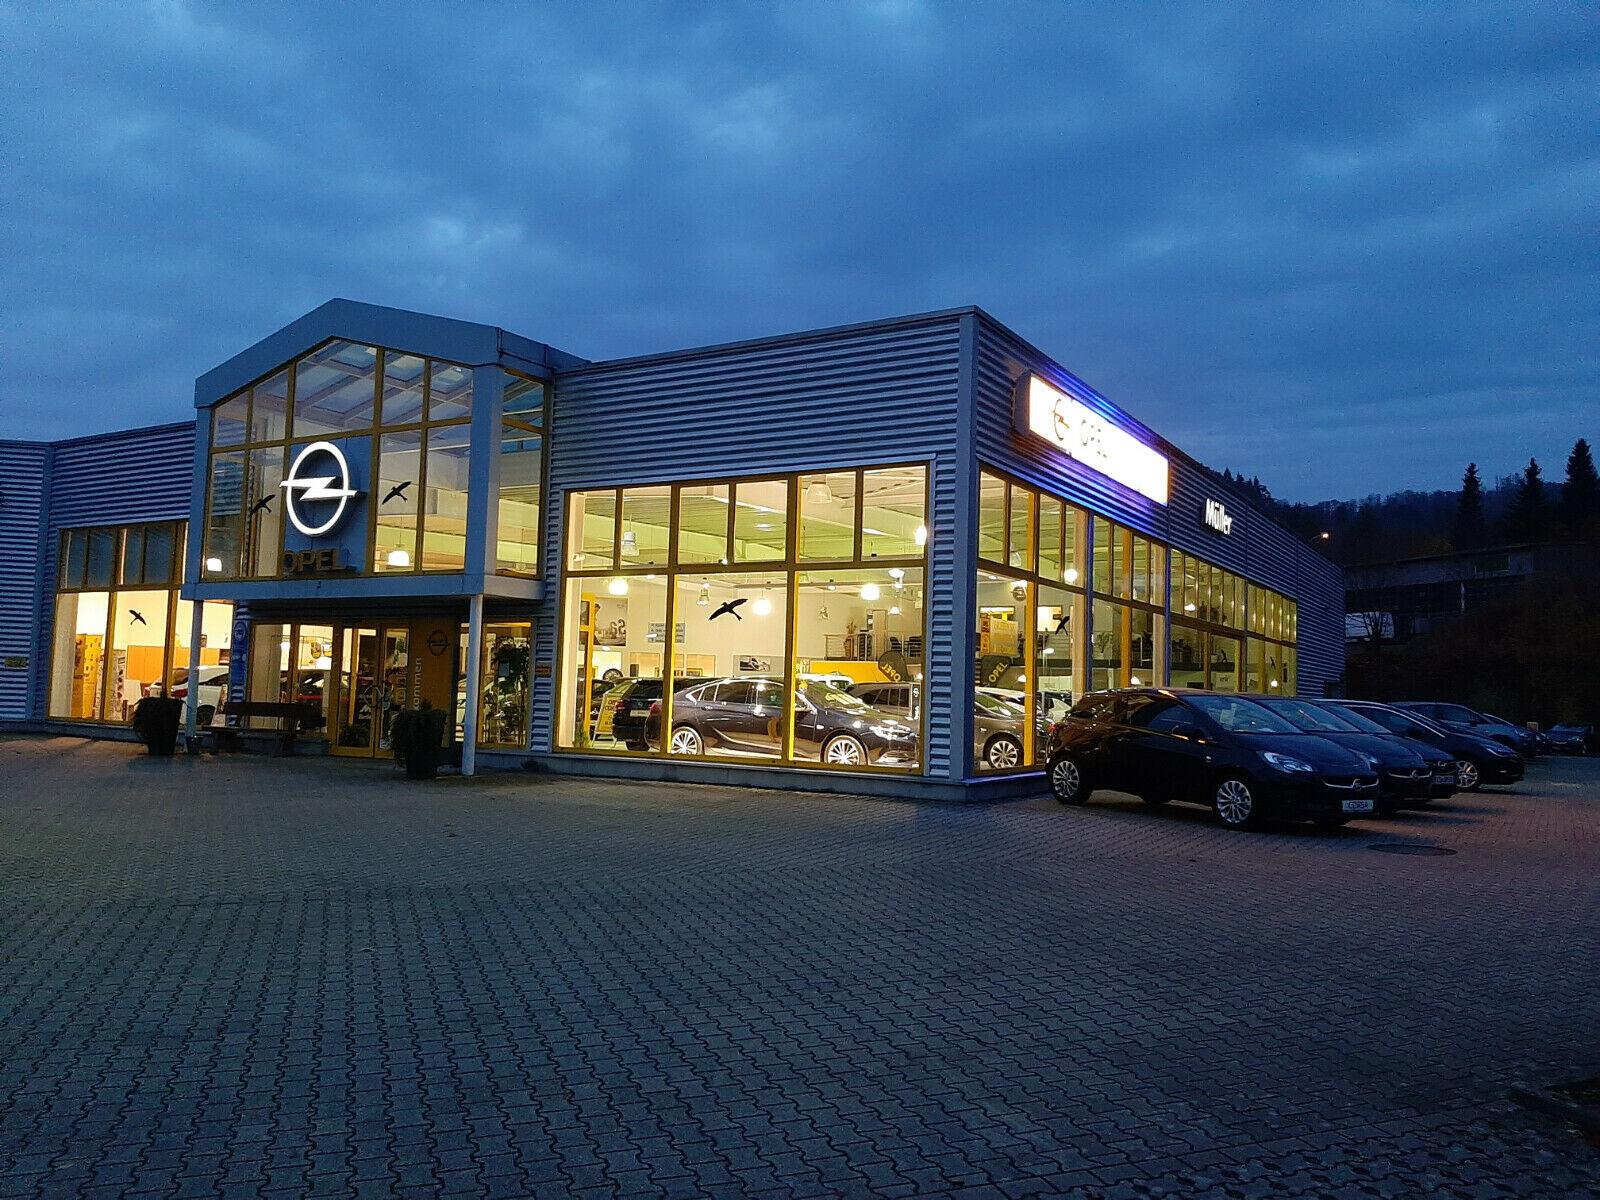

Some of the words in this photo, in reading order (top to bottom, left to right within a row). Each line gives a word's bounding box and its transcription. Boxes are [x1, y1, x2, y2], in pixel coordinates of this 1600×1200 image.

[1205, 498, 1232, 535] Müller
[282, 548, 347, 573] OPEL
[989, 662, 1008, 683] OPEL
